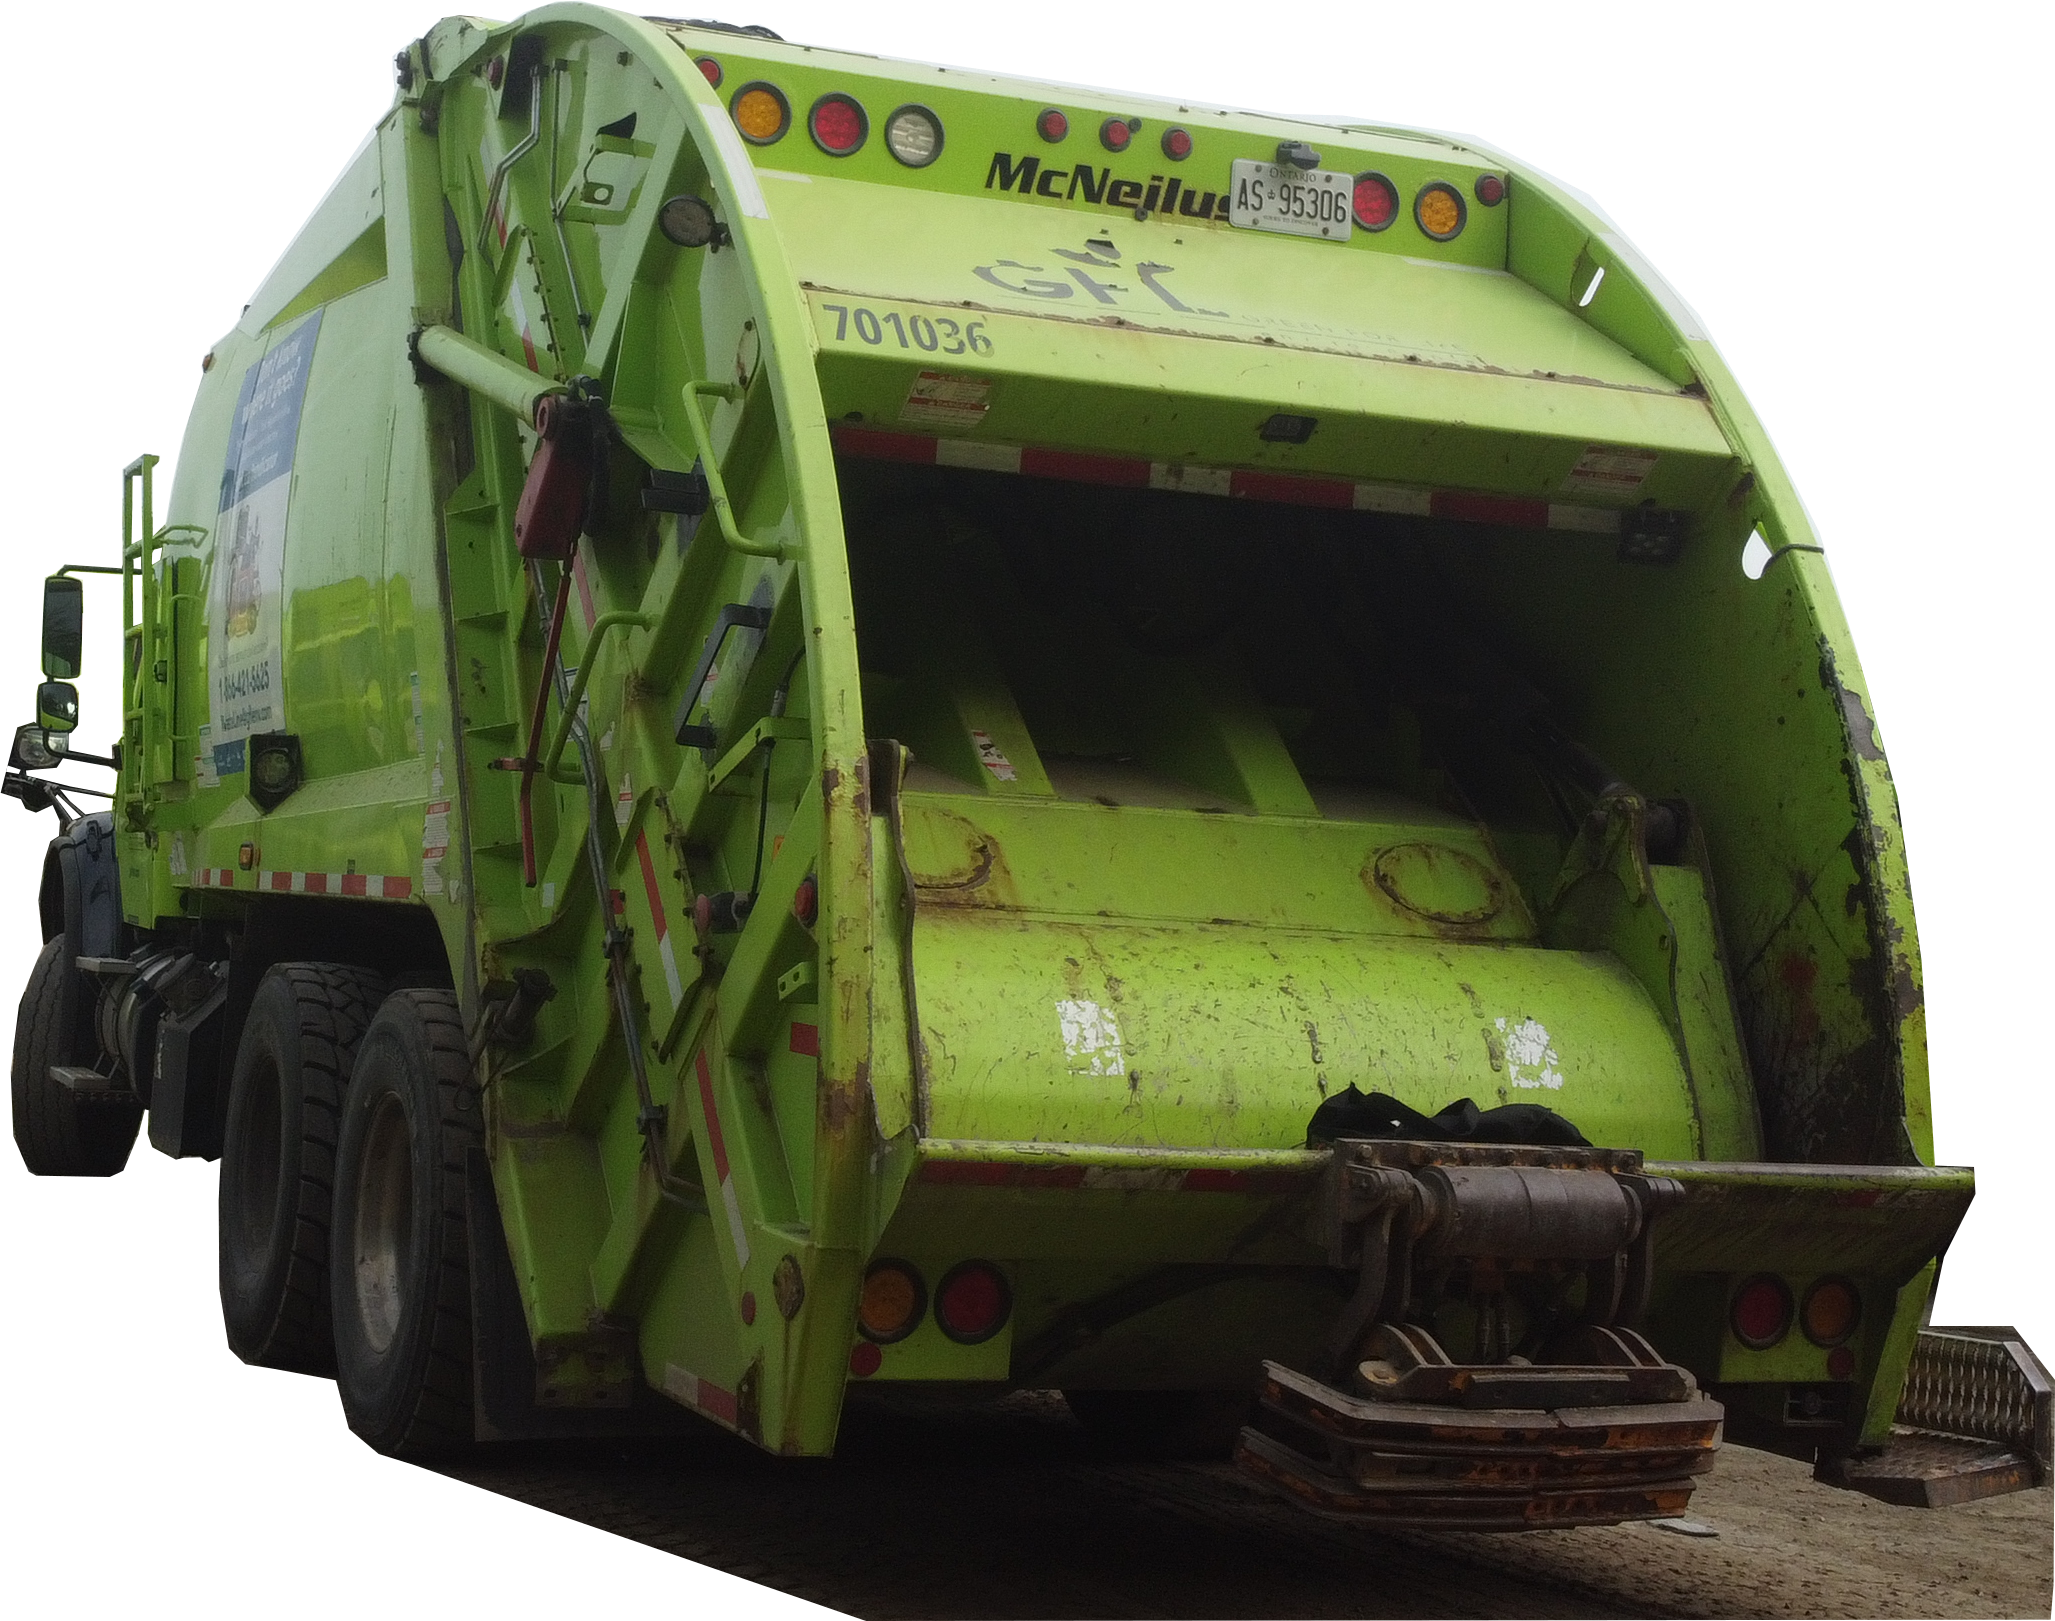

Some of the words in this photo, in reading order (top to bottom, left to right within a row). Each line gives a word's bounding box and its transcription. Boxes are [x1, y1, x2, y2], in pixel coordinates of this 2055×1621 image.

[1269, 167, 1317, 182] ONTARIO
[1237, 178, 1264, 211] AS
[1278, 183, 1347, 223] 95306
[822, 304, 994, 358] 701036
